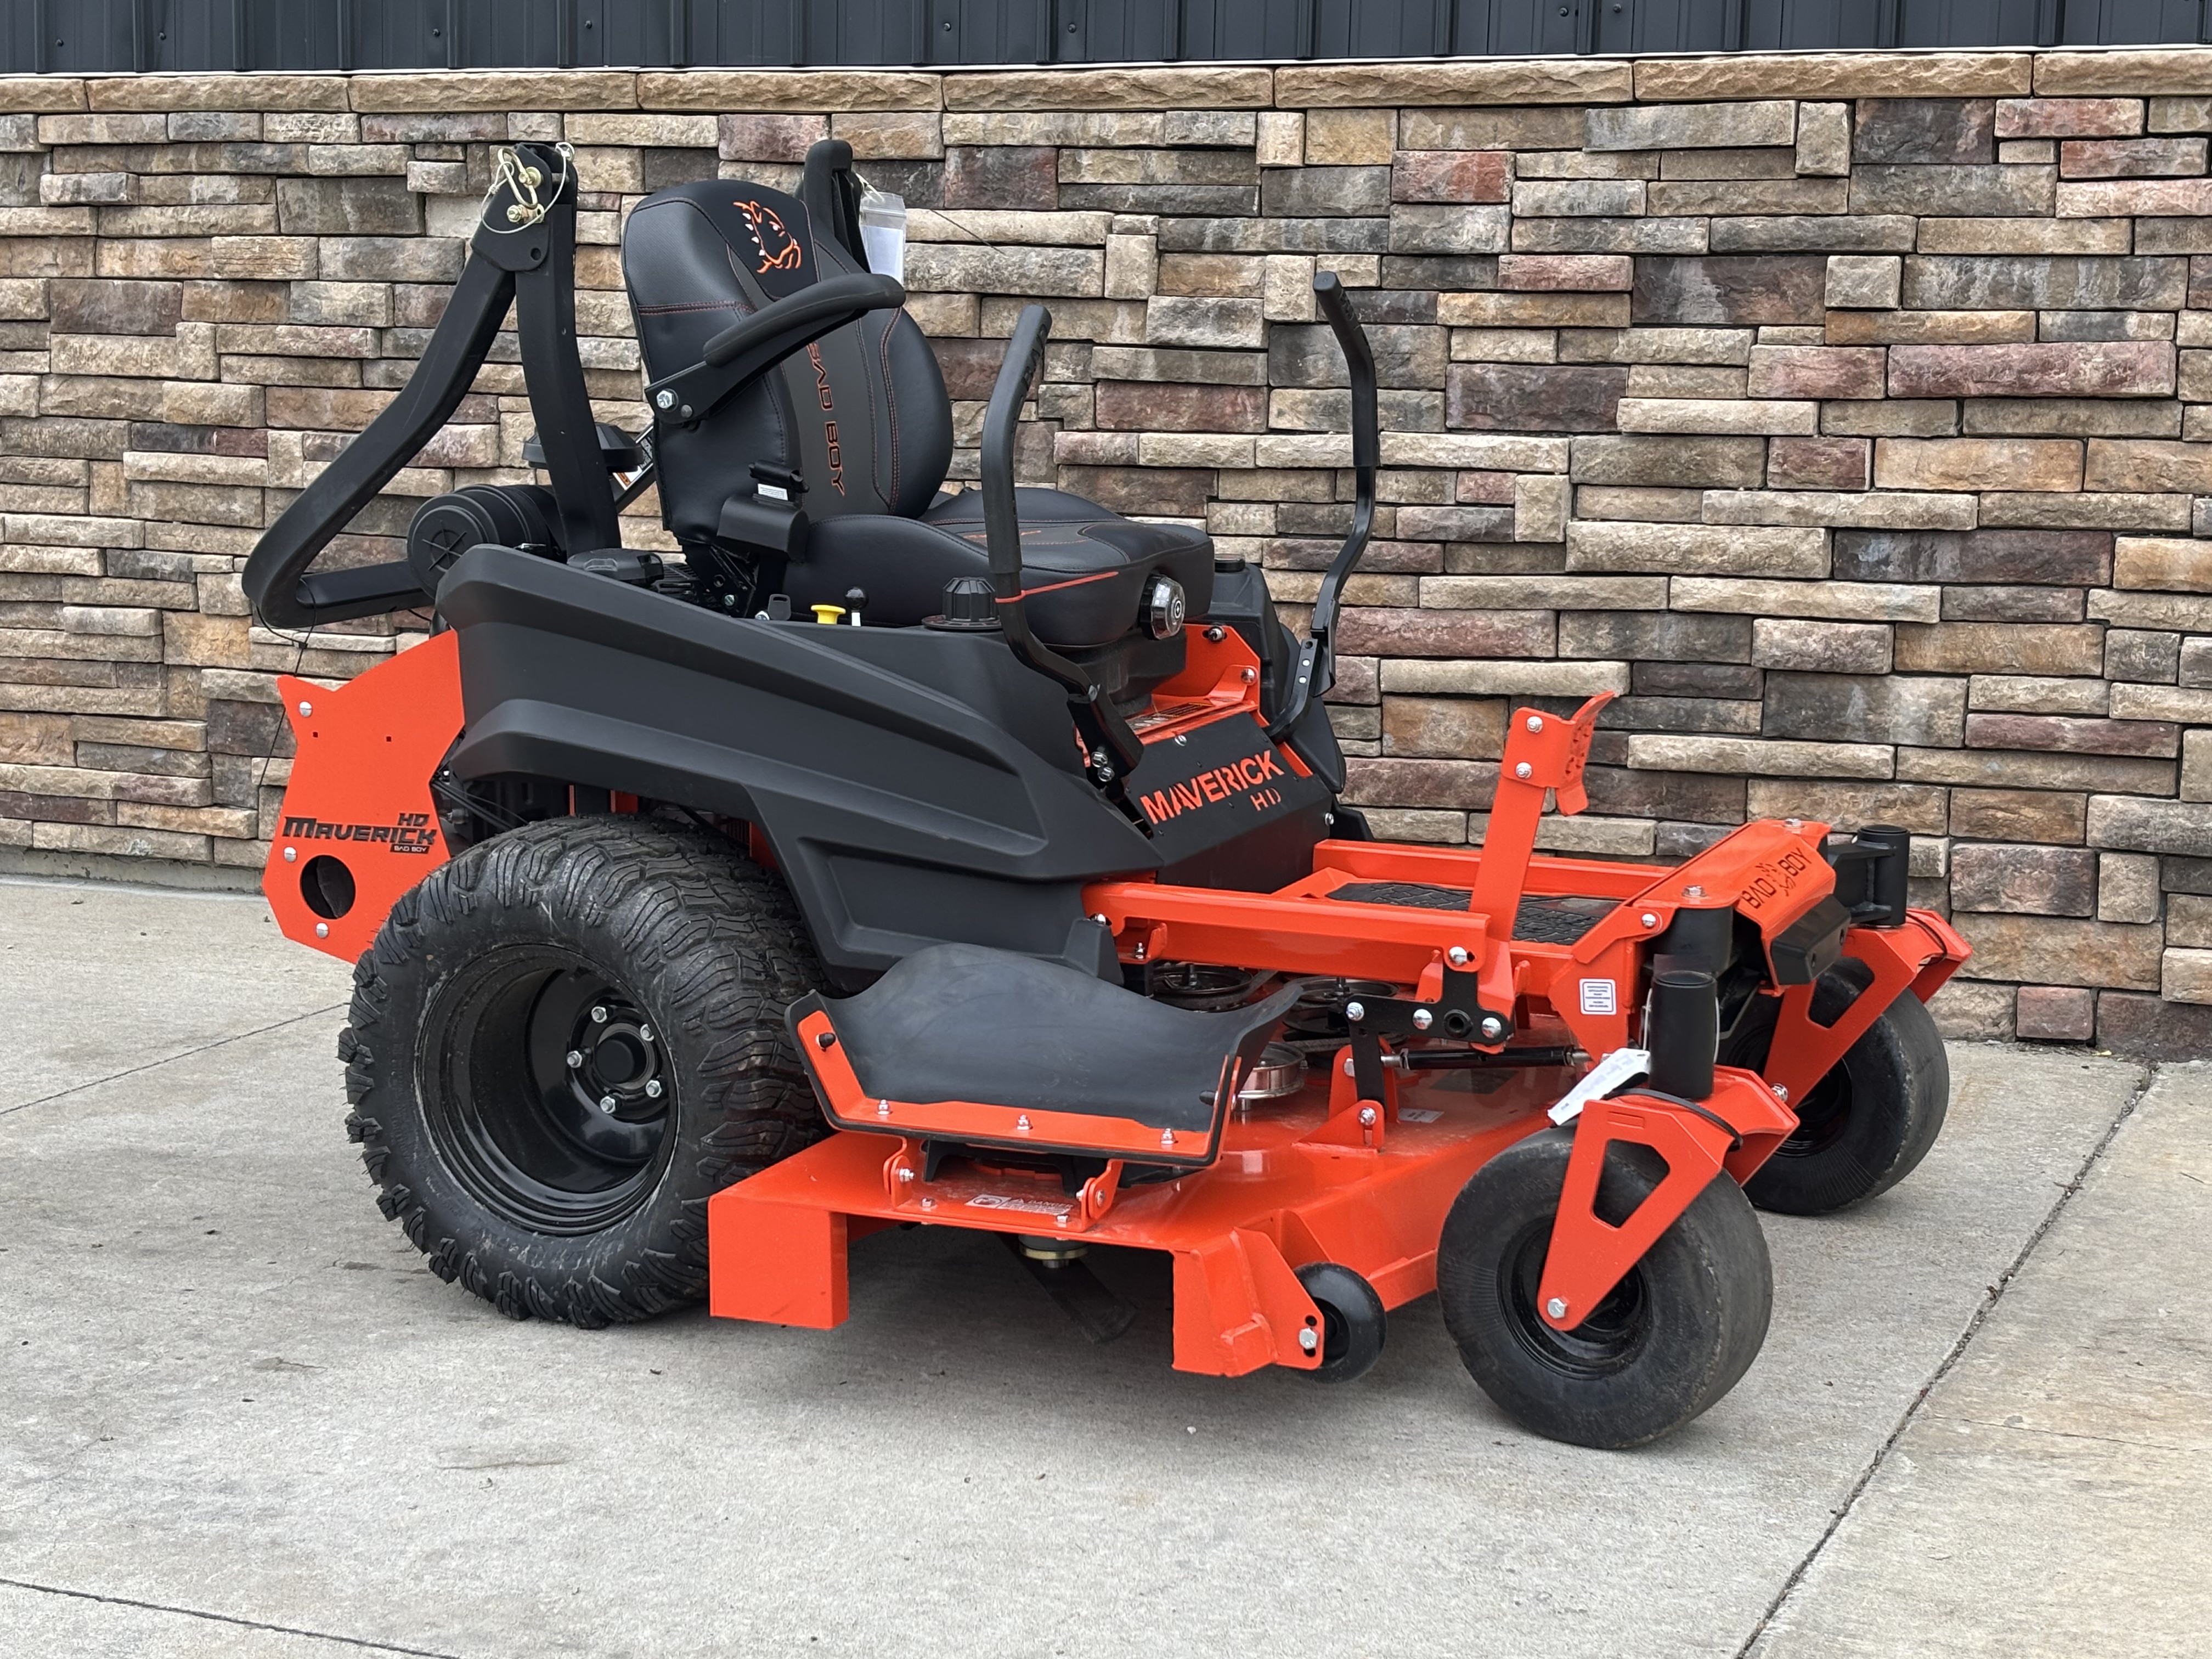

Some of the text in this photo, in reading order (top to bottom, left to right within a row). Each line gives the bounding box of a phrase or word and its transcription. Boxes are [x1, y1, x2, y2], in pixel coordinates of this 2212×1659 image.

[825, 421, 845, 496] BOY
[1139, 749, 1285, 825] MAVERICK
[1249, 787, 1282, 812] HD
[397, 812, 430, 827] HD
[1741, 847, 1812, 909] BAD BOY
